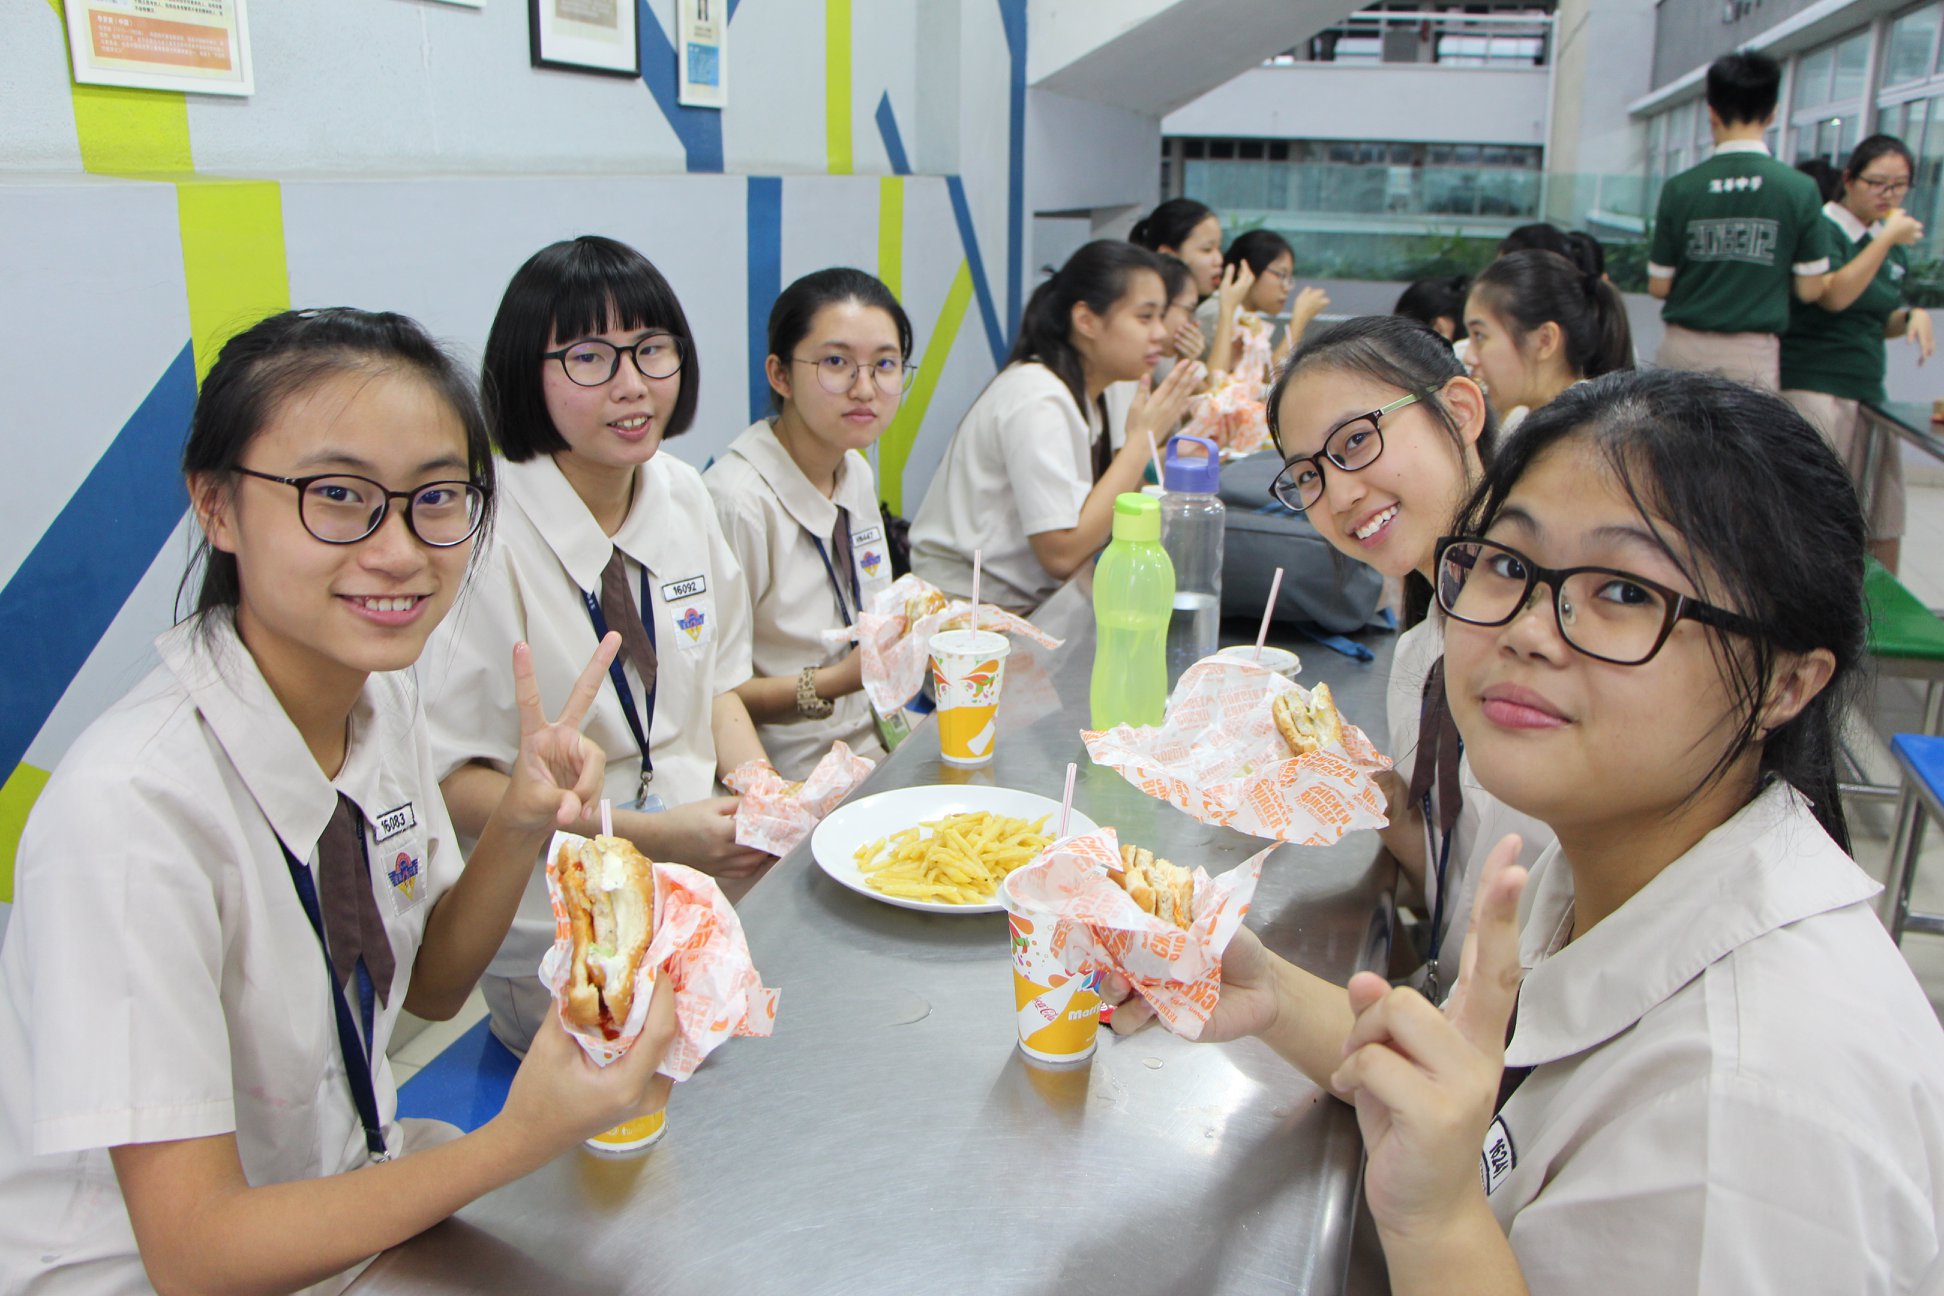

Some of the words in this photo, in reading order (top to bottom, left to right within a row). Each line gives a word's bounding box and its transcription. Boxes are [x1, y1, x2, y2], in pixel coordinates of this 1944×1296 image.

[673, 581, 697, 596] 16092
[380, 812, 406, 835] 16083
[1489, 1138, 1509, 1180] 16241
